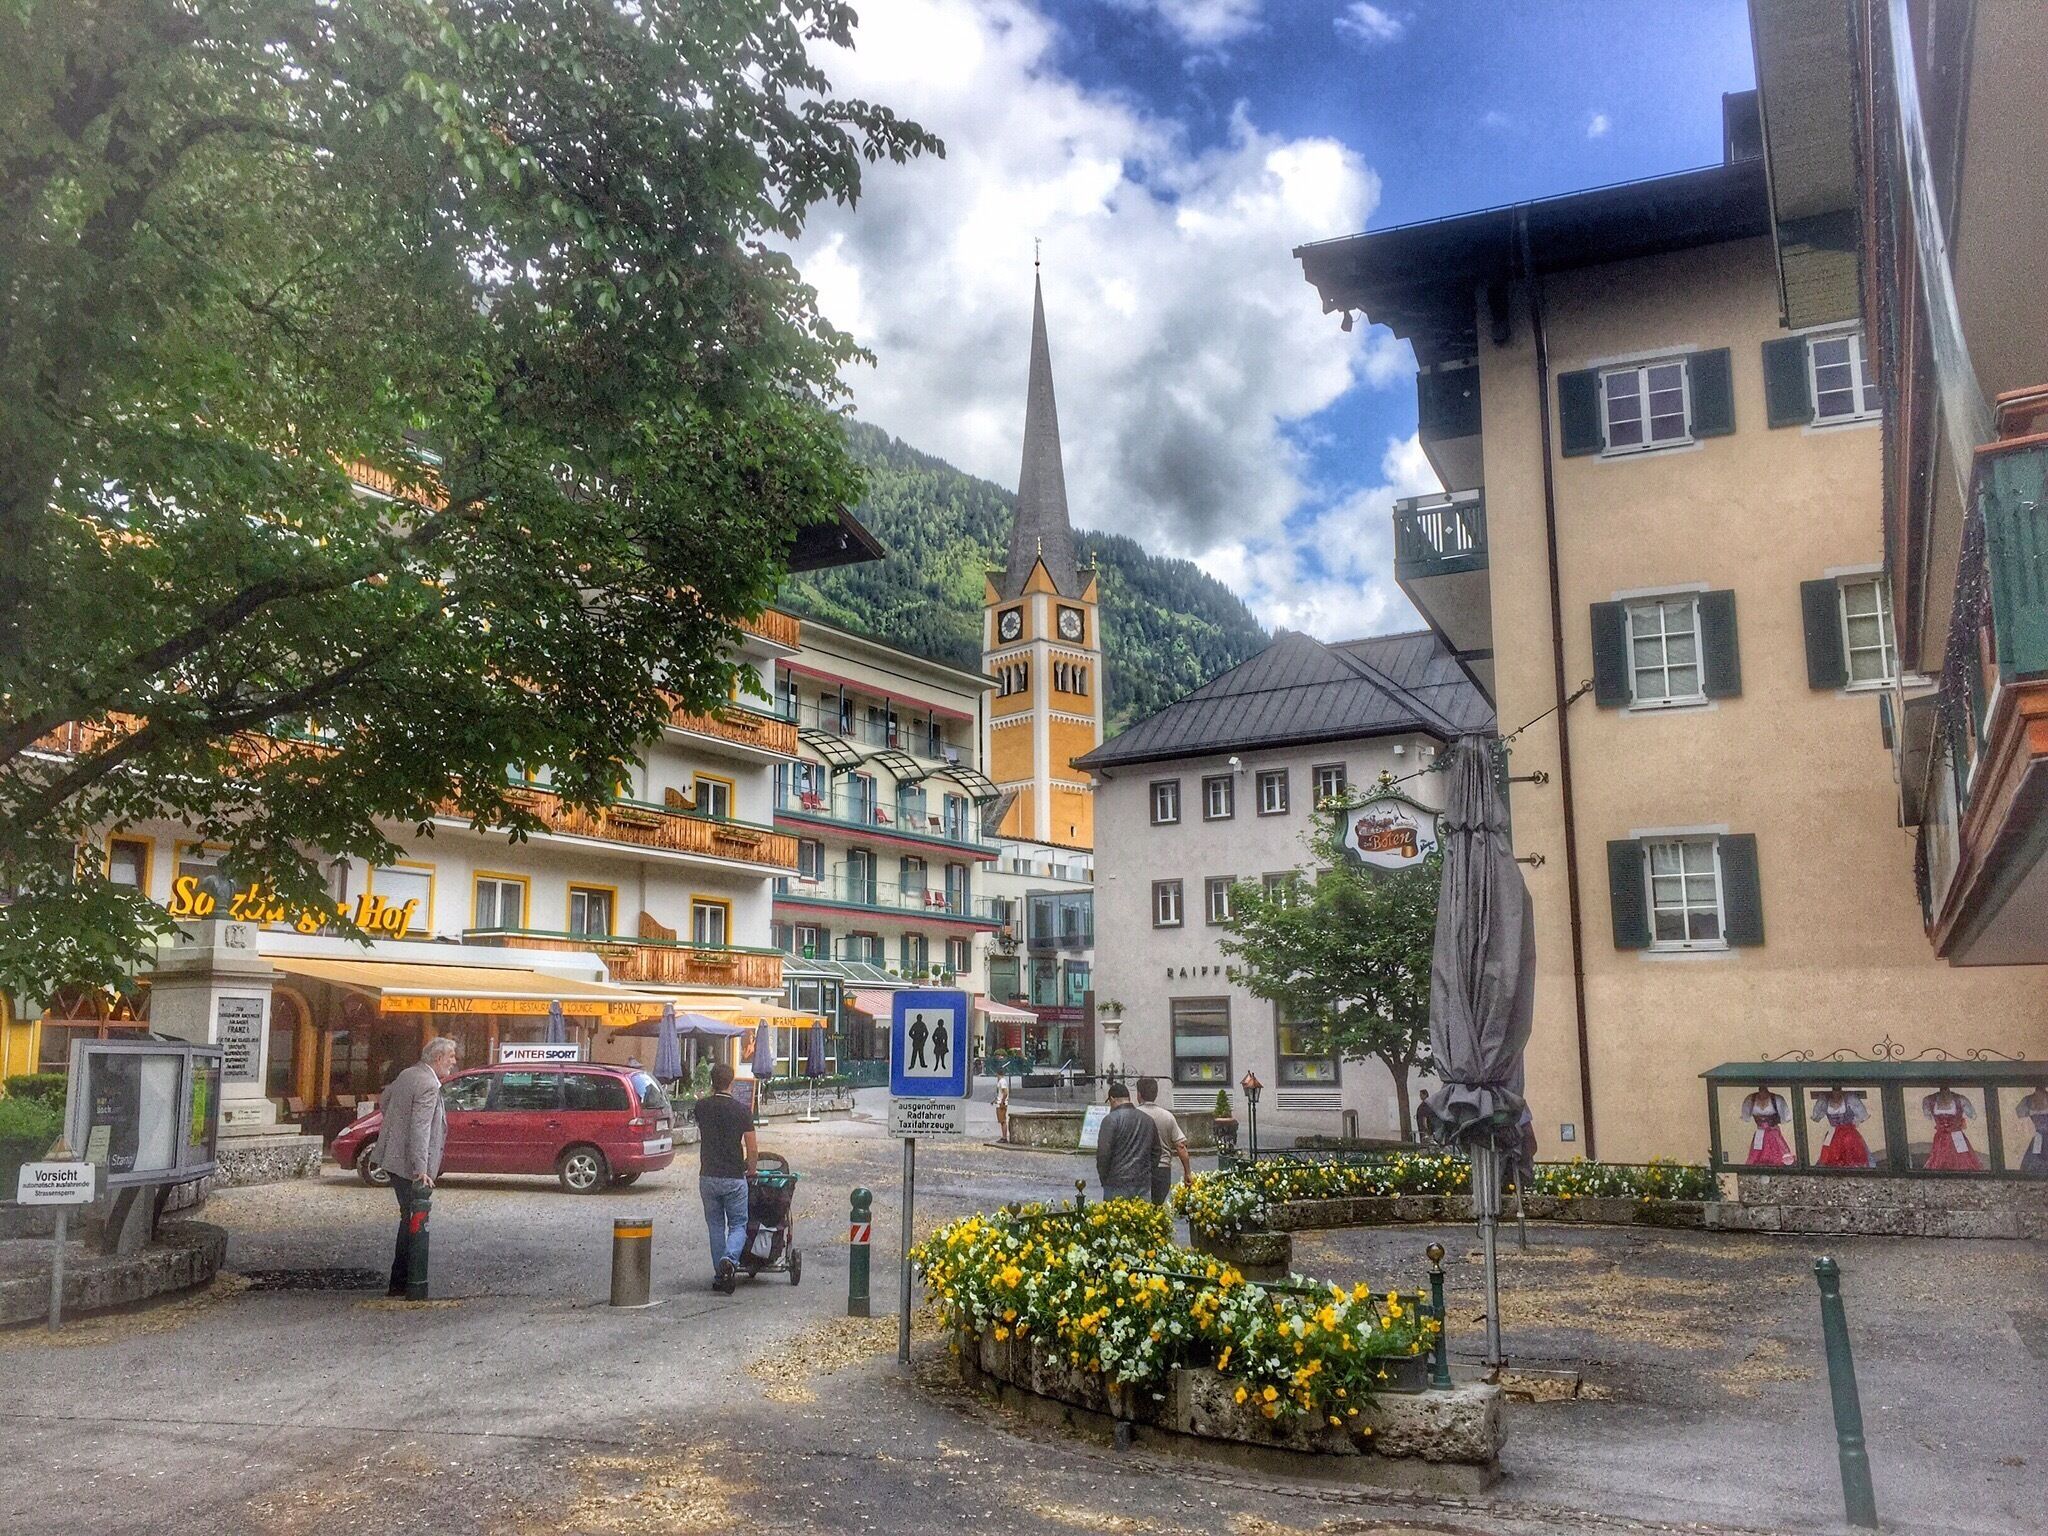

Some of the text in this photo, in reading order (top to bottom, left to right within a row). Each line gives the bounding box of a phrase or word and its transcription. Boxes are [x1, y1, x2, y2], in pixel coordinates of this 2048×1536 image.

[354, 893, 420, 939] Hof
[435, 997, 473, 1012] FRANZ
[613, 1003, 642, 1014] FRANZ
[898, 1103, 956, 1111] ausgenommen
[907, 1111, 946, 1119] Radfahrer
[898, 1119, 954, 1131] Taxifahrzeuge
[35, 1169, 78, 1182] Vorsicht
